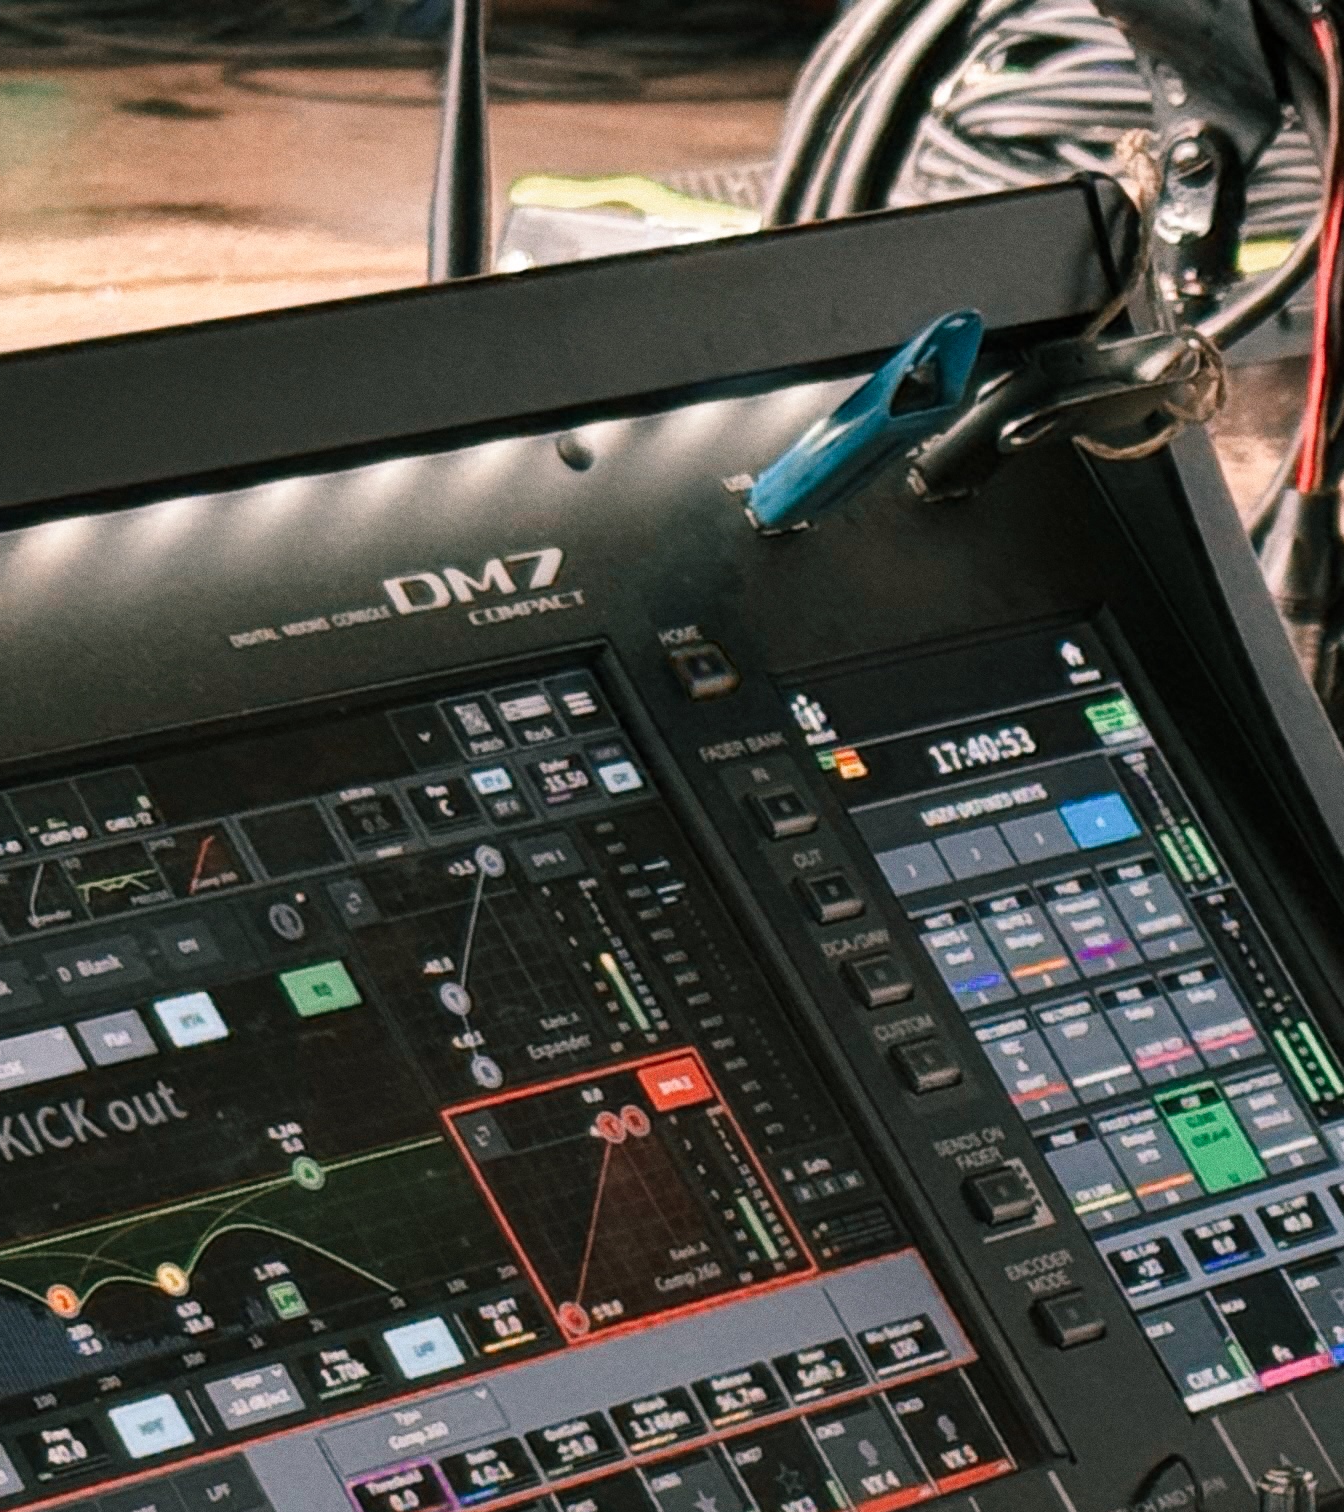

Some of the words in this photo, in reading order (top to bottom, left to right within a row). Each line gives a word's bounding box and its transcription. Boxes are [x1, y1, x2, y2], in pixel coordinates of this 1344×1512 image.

[383, 547, 563, 615] DM7
[468, 589, 586, 626] COMPACT
[658, 624, 703, 647] HOME
[699, 740, 747, 763] FADER
[745, 732, 787, 752] BANK
[927, 726, 1037, 774] 17:40:53
[437, 799, 454, 817] C
[792, 849, 823, 869] OUT
[56, 965, 73, 982] D
[75, 953, 124, 977] Blank
[873, 1013, 936, 1041] CUSTOM
[526, 1032, 593, 1061] Expander
[103, 1079, 188, 1133] out
[955, 1146, 1005, 1170] FADER
[1005, 1250, 1074, 1281] ENCODER
[653, 1269, 698, 1294] Comp
[1027, 1269, 1073, 1294] MODE
[1186, 1368, 1218, 1390] CUE
[939, 1448, 965, 1469] VX
[861, 1473, 888, 1495] VX
[387, 1488, 421, 1512] 0.0
